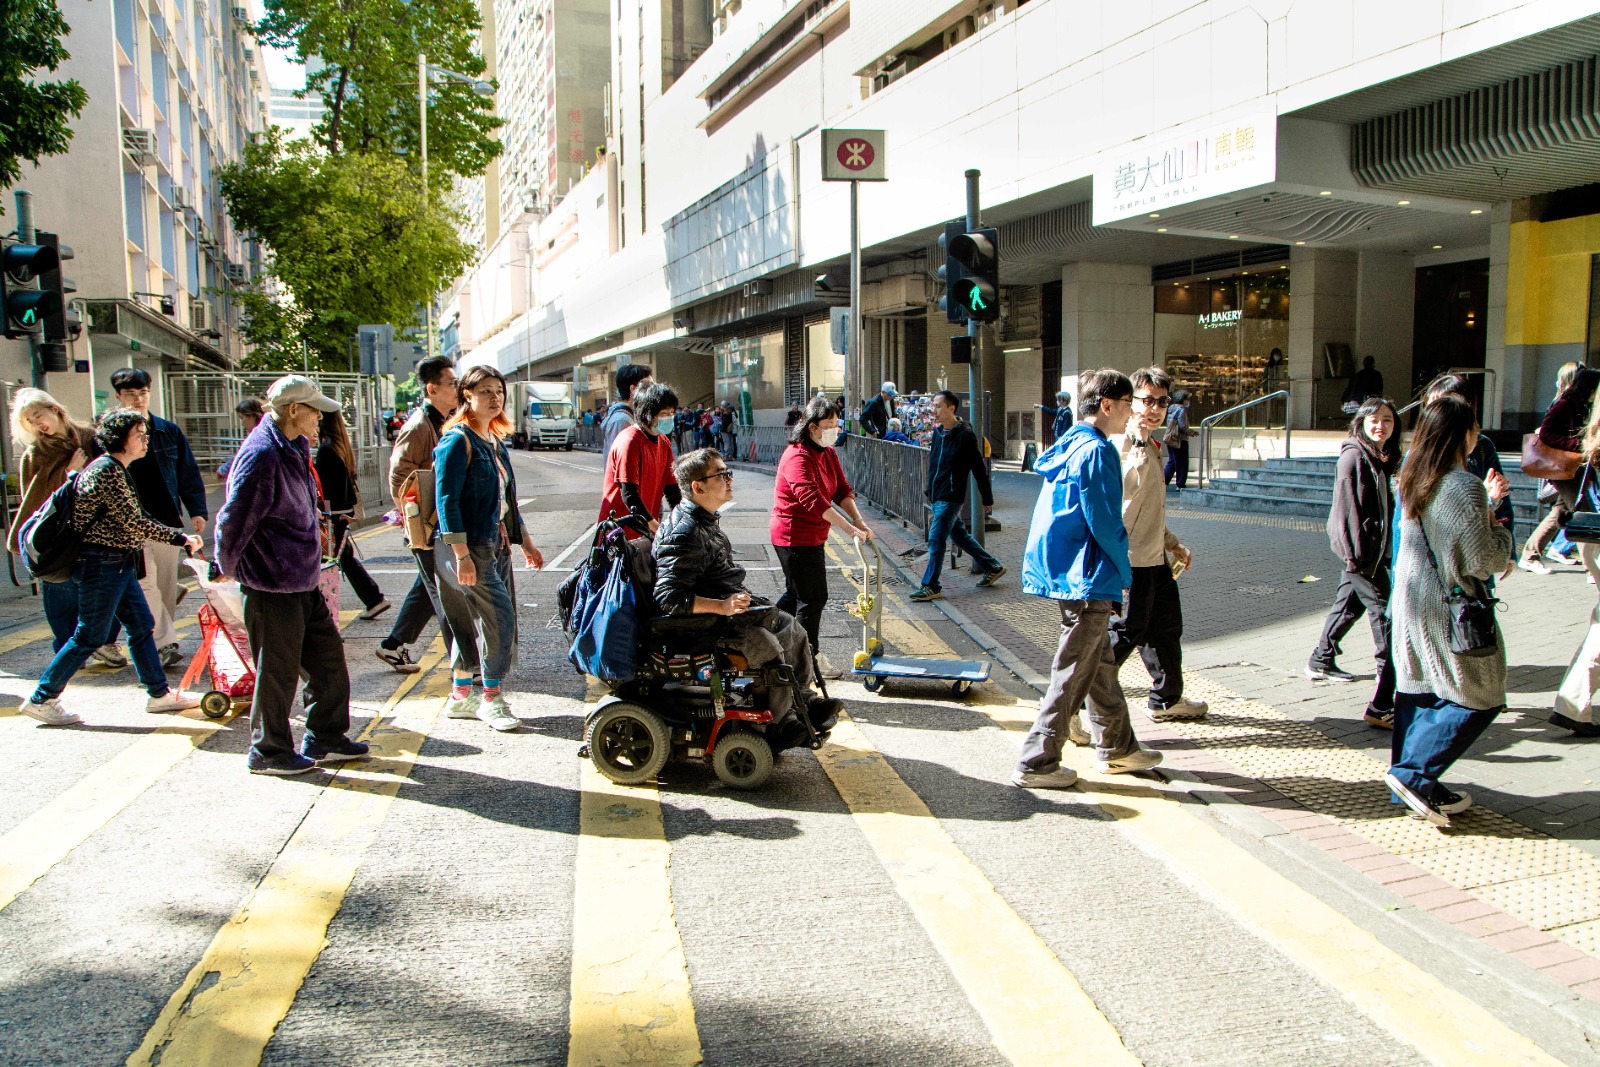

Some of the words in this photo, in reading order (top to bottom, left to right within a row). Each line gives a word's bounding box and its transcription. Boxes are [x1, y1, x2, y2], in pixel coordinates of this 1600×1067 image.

[1215, 155, 1255, 171] SOUTH
[1113, 195, 1156, 213] TEMPLE
[1164, 185, 1198, 199] MALL
[1211, 309, 1243, 323] BAKERY
